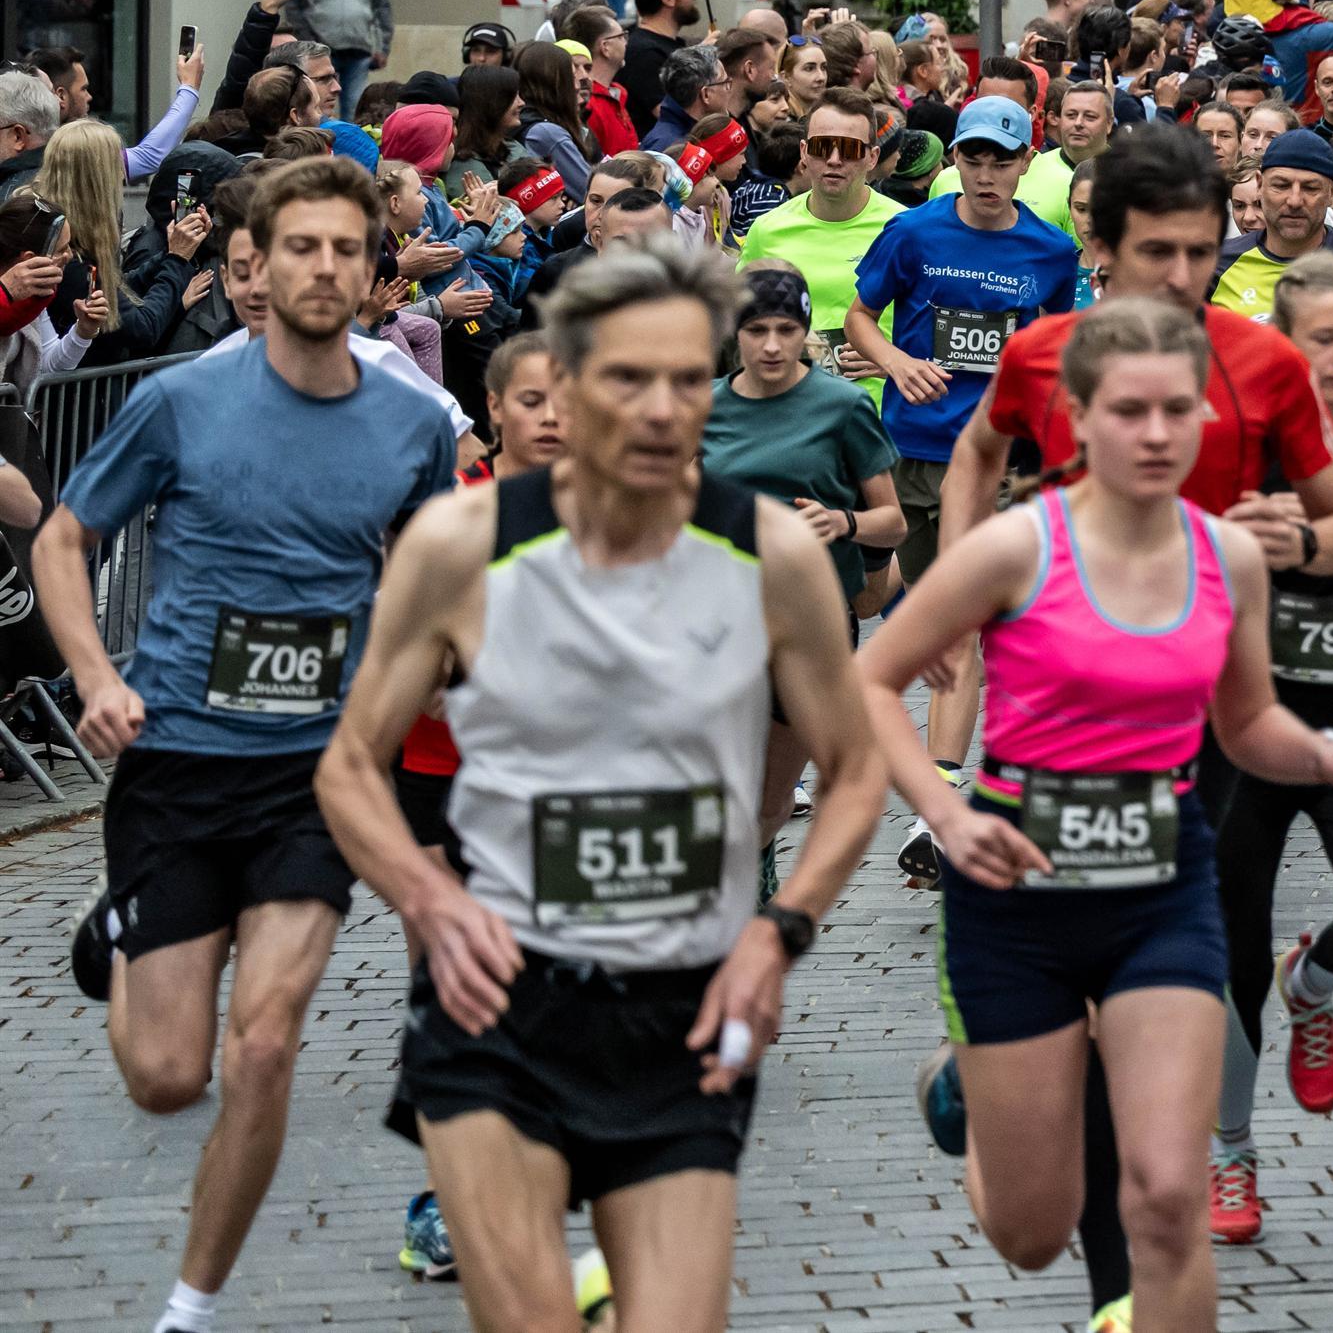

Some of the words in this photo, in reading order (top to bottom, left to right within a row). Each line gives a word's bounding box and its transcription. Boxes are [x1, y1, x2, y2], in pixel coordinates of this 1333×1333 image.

[923, 265, 985, 281] Sparkassen
[987, 271, 1018, 286] Cross
[980, 281, 1017, 295] Pforzheim
[950, 326, 1000, 353] 506
[947, 351, 999, 363] JOHANNES
[246, 642, 323, 683] 706
[239, 681, 319, 697] JOHANNES
[1059, 802, 1150, 850] 545
[577, 825, 688, 881] 511
